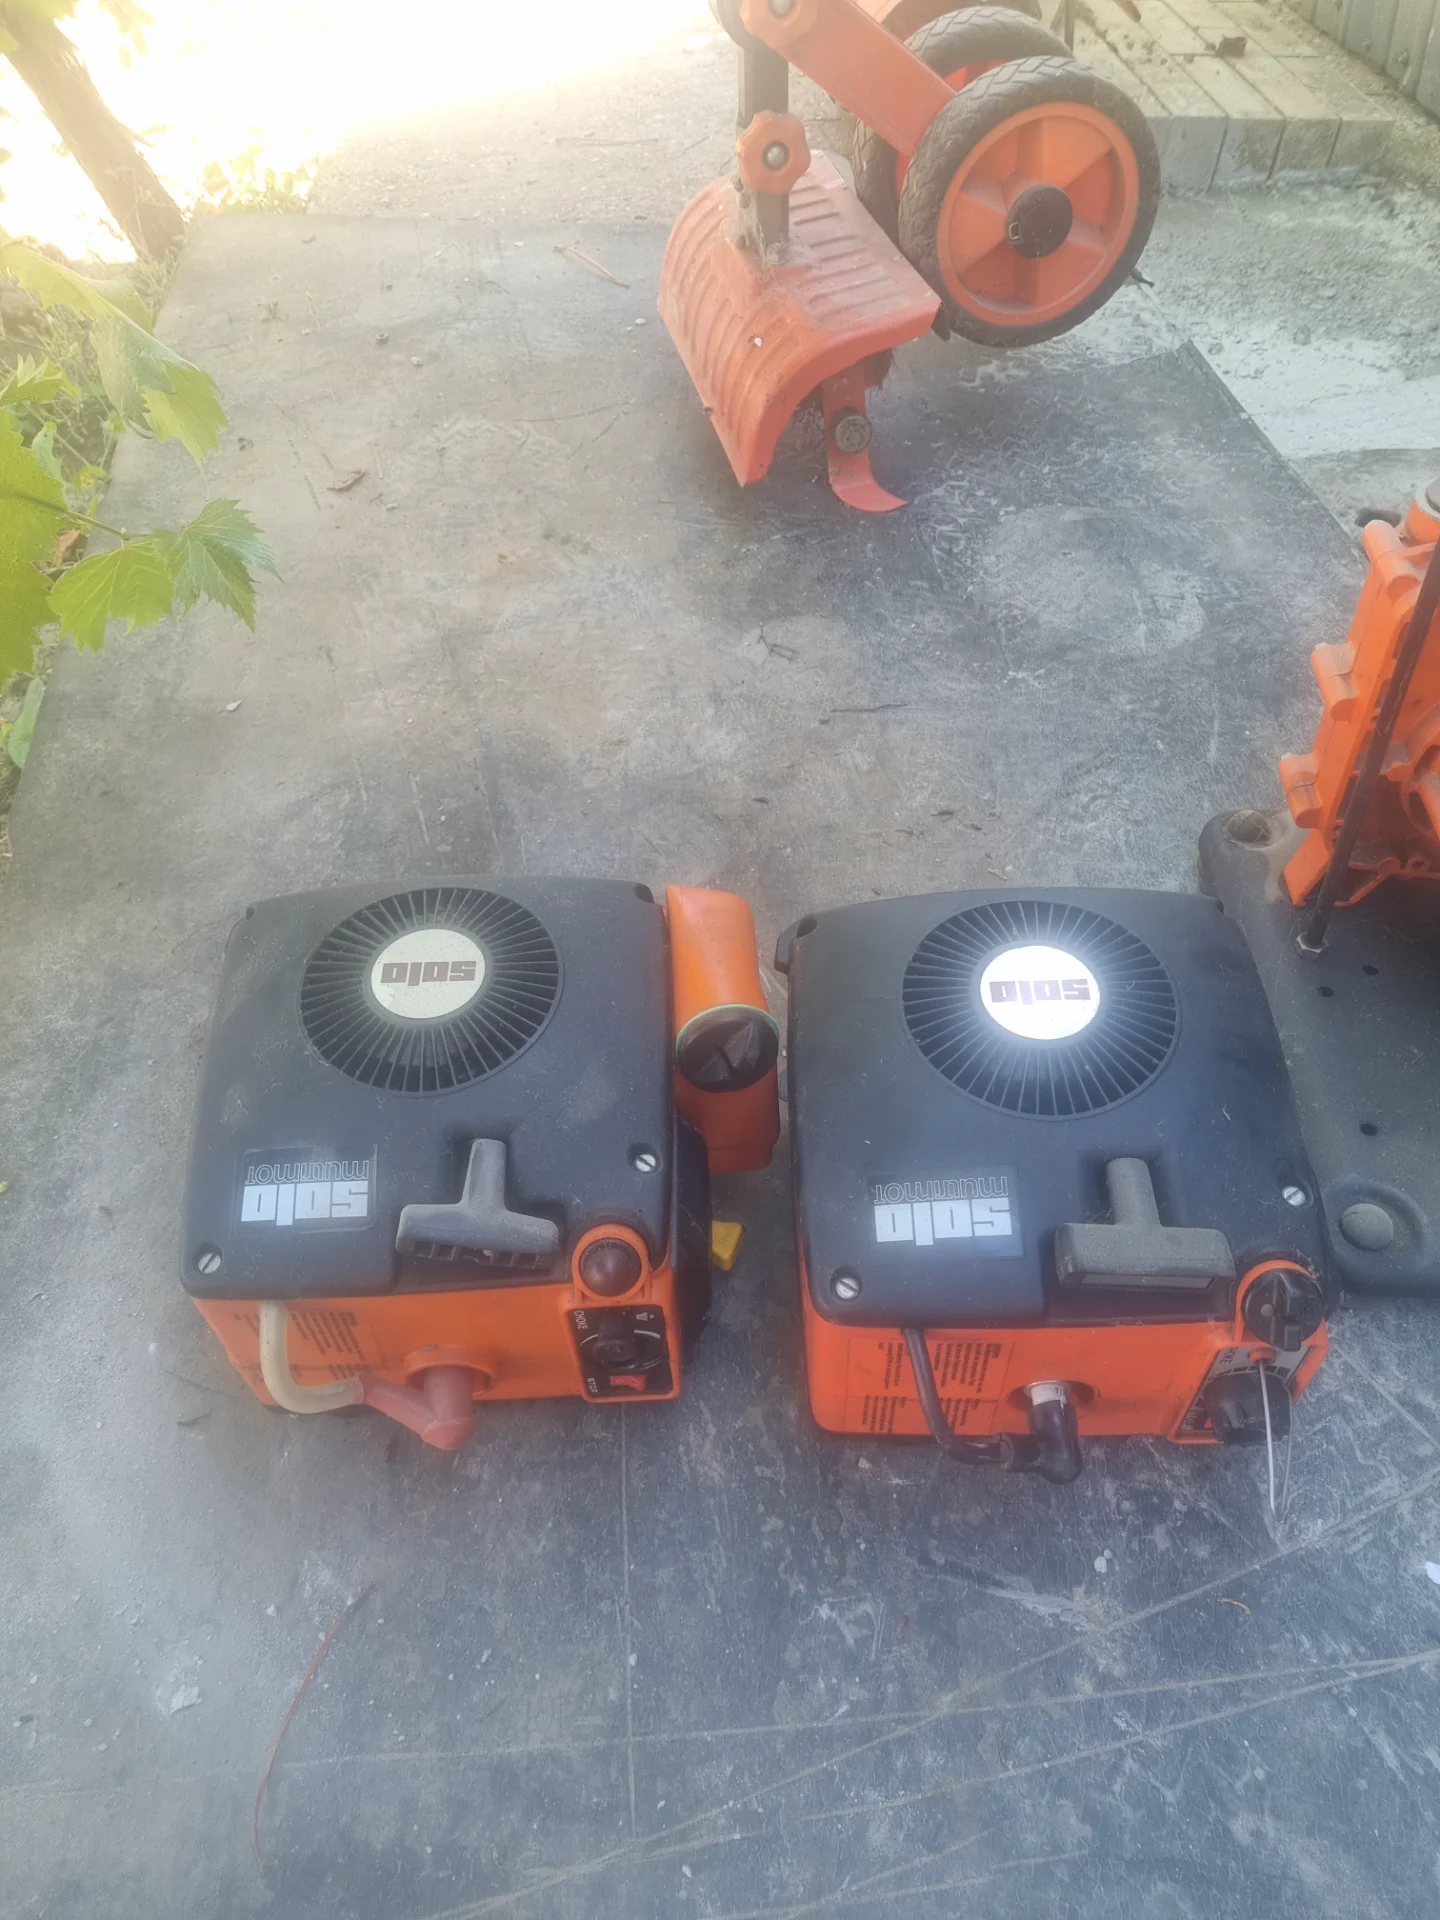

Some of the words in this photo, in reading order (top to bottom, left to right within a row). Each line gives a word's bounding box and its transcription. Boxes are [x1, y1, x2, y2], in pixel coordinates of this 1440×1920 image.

[381, 961, 476, 986] solo
[989, 979, 1091, 1005] solo
[245, 1160, 369, 1185] multimot
[873, 1176, 1009, 1204] multimot
[241, 1181, 368, 1226] solo
[874, 1197, 1012, 1246] solo
[573, 1309, 588, 1330] CHOKE
